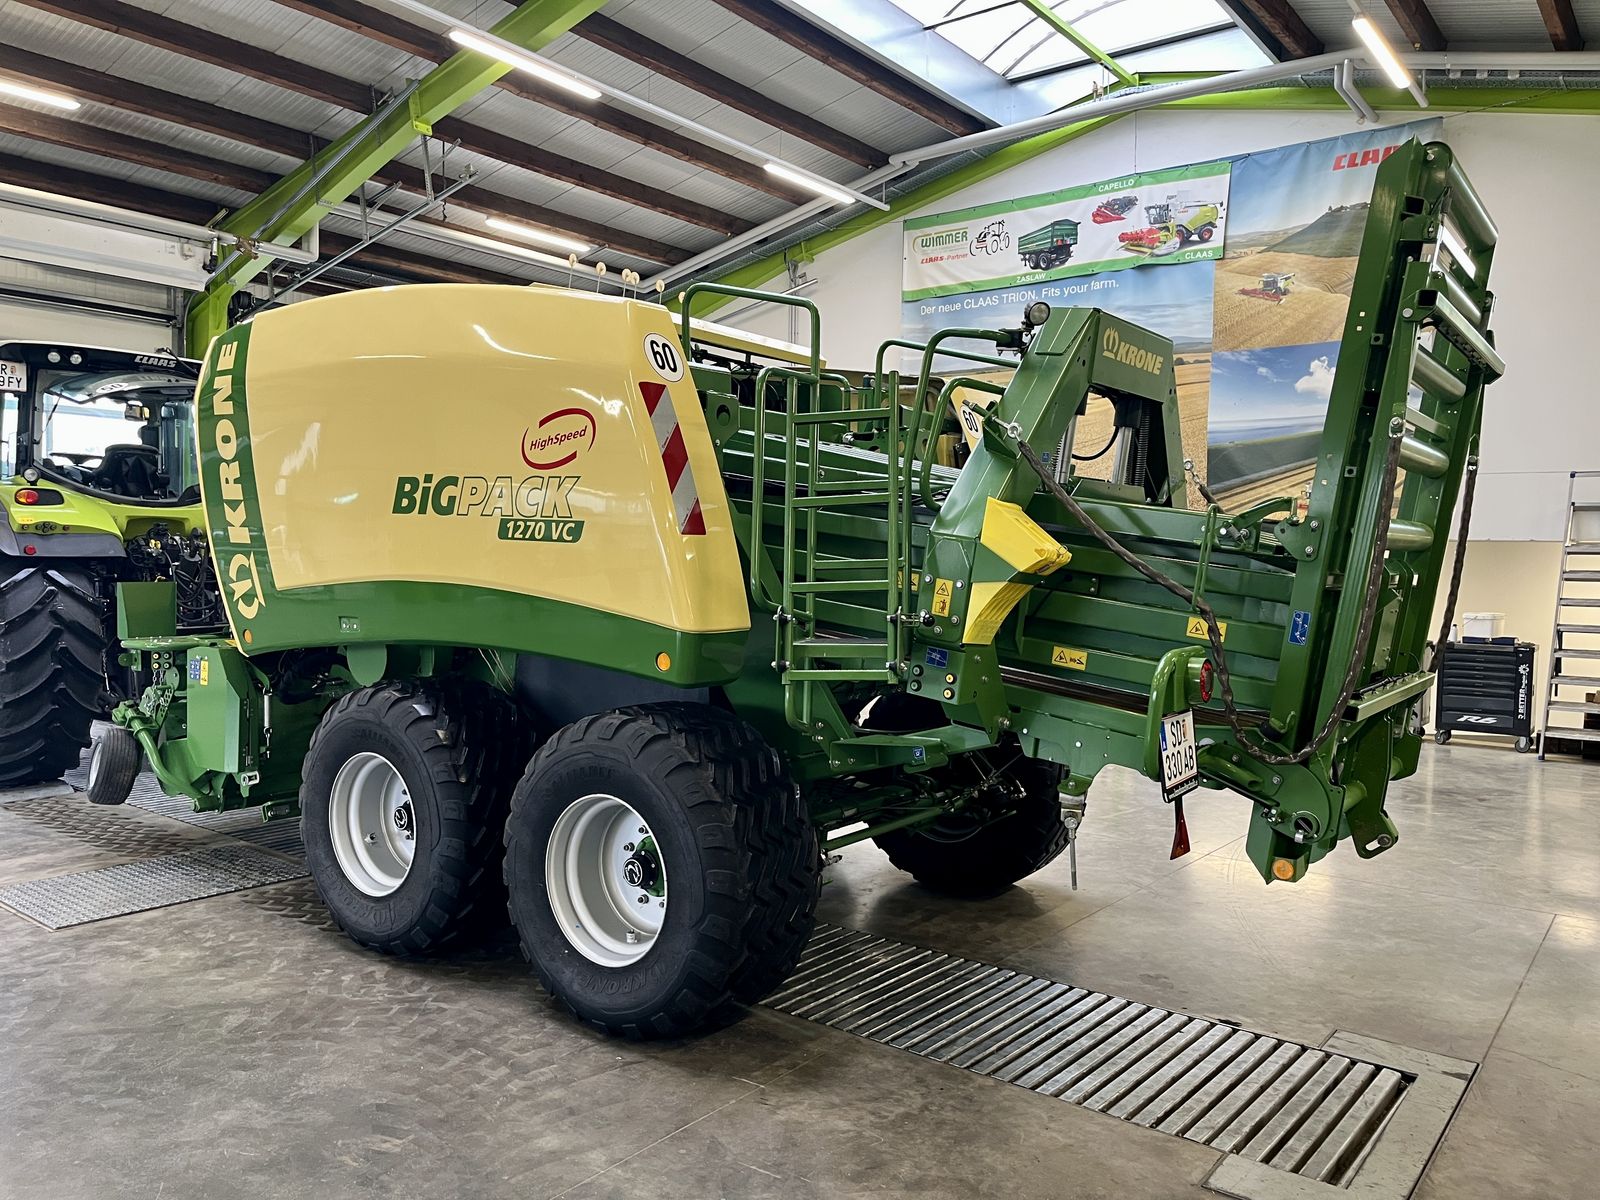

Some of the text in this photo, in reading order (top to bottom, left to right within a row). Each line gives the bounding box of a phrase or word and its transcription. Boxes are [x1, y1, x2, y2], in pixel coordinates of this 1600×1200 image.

[1098, 179, 1135, 192] CAPELLO
[921, 231, 968, 248] WIMMER
[1185, 250, 1213, 260] CLAAS
[1015, 273, 1046, 284] ZASLAW
[920, 278, 1120, 316] Der neue CLAAS TRION. Fits your farm.
[134, 355, 178, 368] CLAAS
[650, 340, 678, 373] 60
[1116, 341, 1164, 375] KRONE
[962, 409, 978, 433] 60
[213, 341, 251, 544] KRONE
[529, 424, 588, 451] HighSpeed
[392, 474, 581, 518] BiGPACK
[506, 521, 576, 541] 1270 VC
[1170, 720, 1182, 748] SD
[1165, 745, 1194, 781] 330 AB
[581, 968, 647, 995] KRONE
